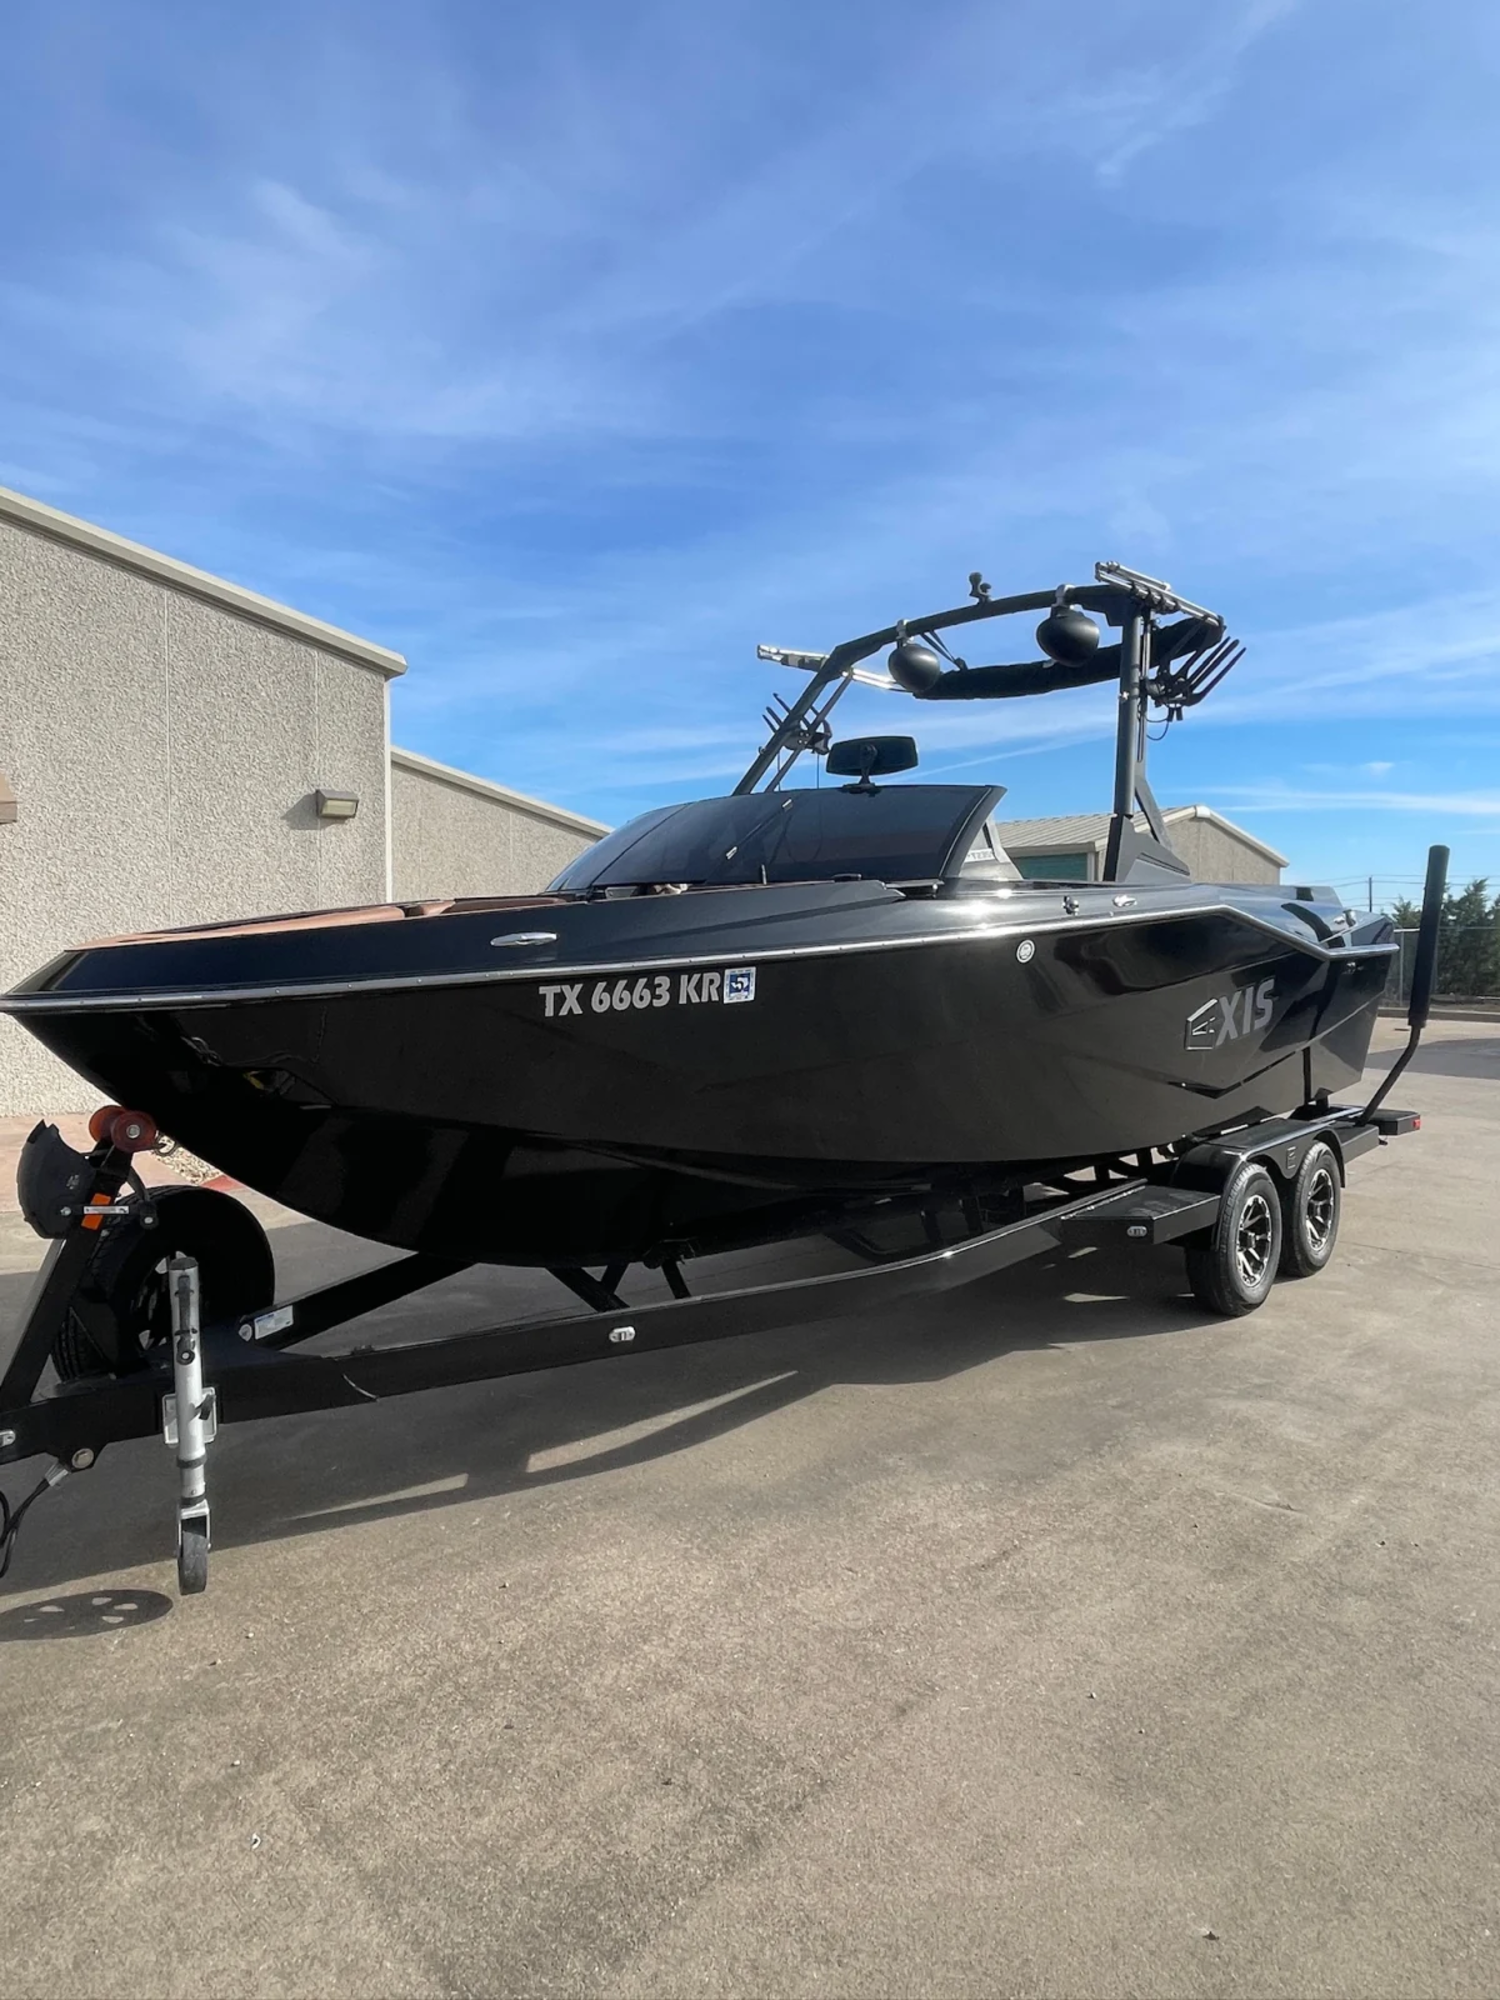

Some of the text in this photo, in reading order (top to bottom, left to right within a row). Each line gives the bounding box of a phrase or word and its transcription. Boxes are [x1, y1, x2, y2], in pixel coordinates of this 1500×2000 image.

[538, 983, 584, 1017] TX
[591, 976, 671, 1013] 6663
[679, 972, 721, 1004] KR
